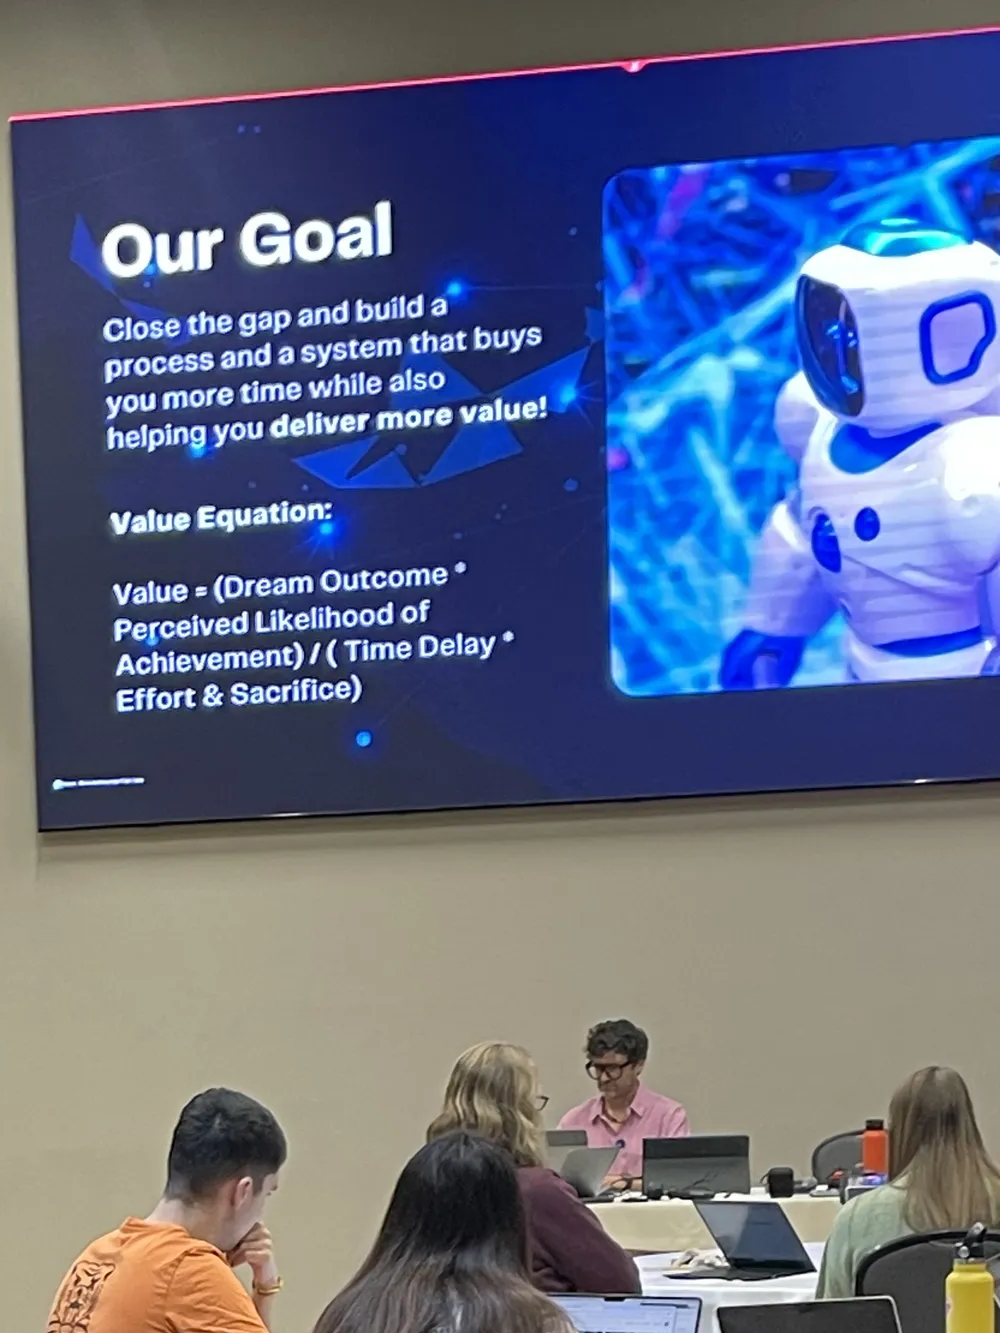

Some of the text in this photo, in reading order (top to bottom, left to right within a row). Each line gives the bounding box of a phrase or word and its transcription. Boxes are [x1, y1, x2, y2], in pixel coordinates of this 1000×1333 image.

[102, 200, 393, 278] Our Goal
[103, 294, 448, 342] Close the gap and build a
[104, 324, 543, 383] process and a system that buys
[106, 368, 445, 419] you more time while also
[106, 396, 548, 452] helping you deliver more value!
[110, 501, 333, 536] Value Equation:
[113, 579, 188, 606] Value
[195, 585, 208, 598] =
[213, 573, 315, 604] (Dream
[320, 565, 448, 593] Outcome
[113, 599, 431, 642] Perceived Likelihood of
[116, 642, 304, 676] Achievement)
[308, 644, 320, 665] /
[345, 637, 412, 662] Time
[419, 633, 495, 661] Delay
[116, 675, 362, 713] Effort & Sacrifice)
